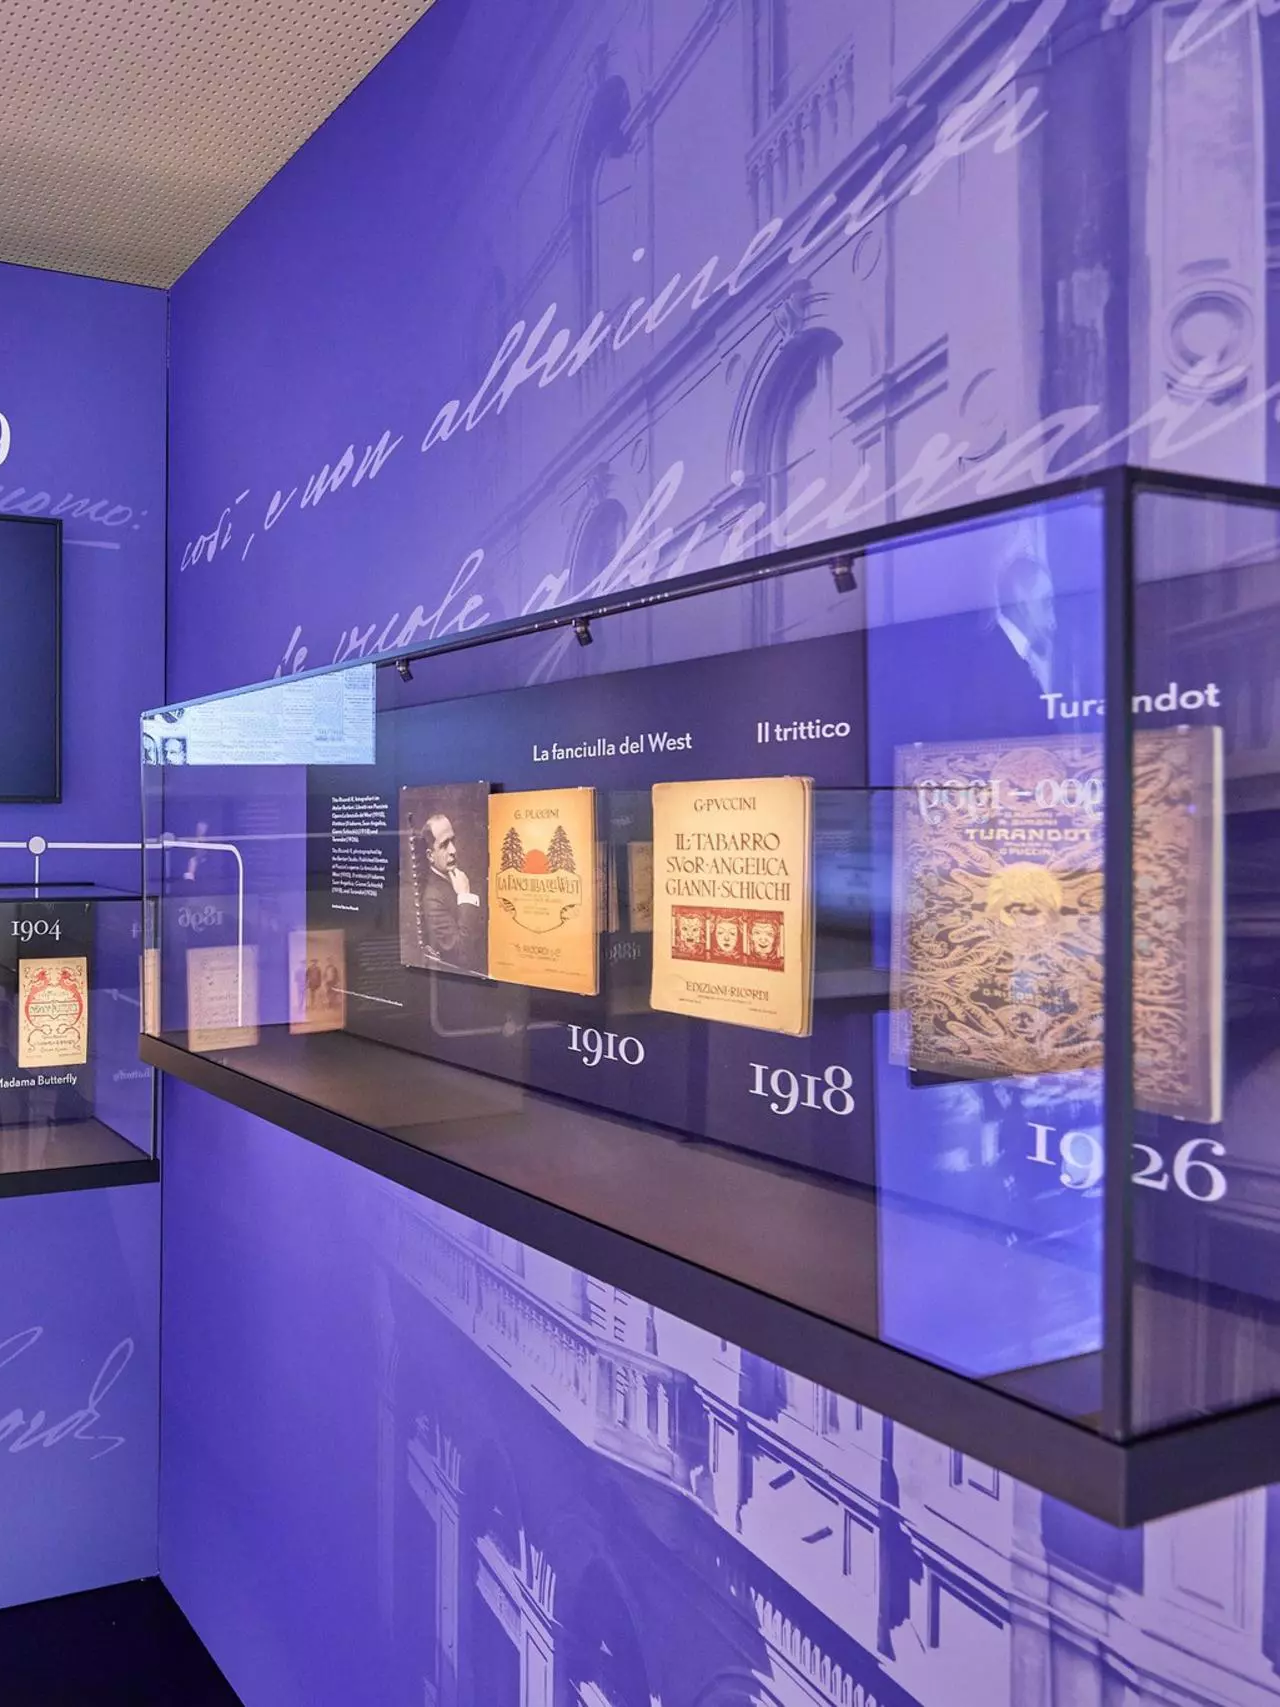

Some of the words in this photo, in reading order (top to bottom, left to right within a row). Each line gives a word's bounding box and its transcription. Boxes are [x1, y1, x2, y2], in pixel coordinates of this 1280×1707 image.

[756, 722, 769, 743] Il
[774, 719, 851, 742] trittico
[532, 744, 549, 762] La
[551, 738, 616, 761] fanciulla
[619, 735, 645, 756] del
[646, 731, 693, 754] West
[964, 828, 1092, 842] TURANDOT
[10, 917, 62, 944] 1904
[567, 1022, 646, 1067] 1910
[37, 1073, 77, 1085] Butterfly
[749, 1062, 856, 1116] 1918
[1025, 1121, 1228, 1203] 1926
